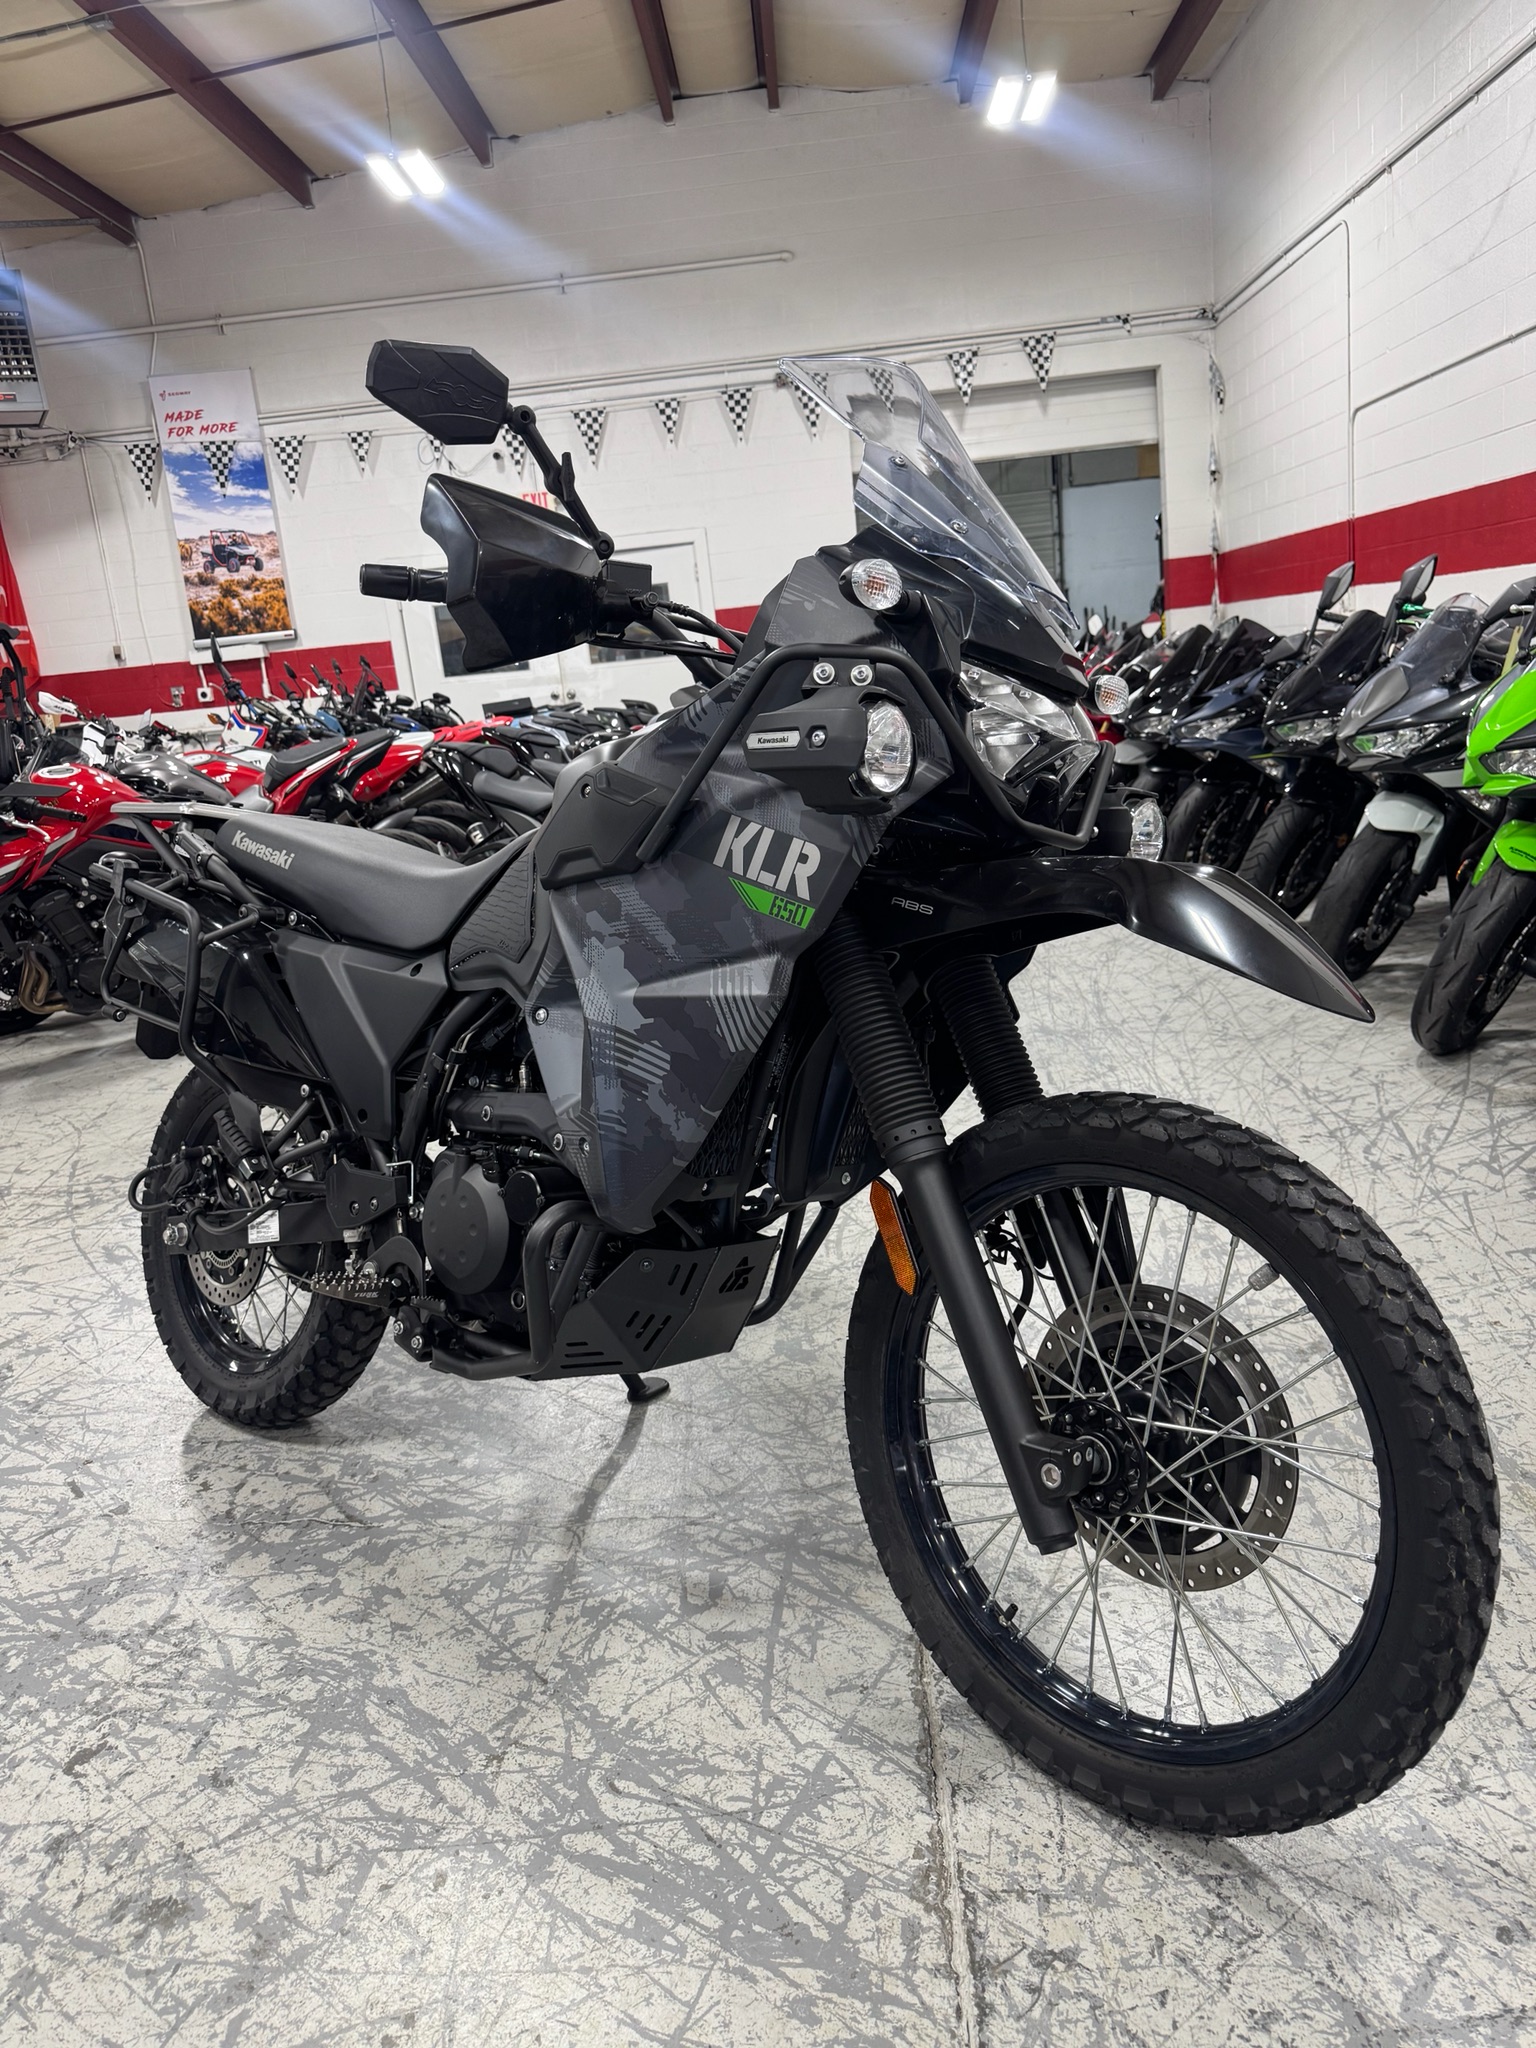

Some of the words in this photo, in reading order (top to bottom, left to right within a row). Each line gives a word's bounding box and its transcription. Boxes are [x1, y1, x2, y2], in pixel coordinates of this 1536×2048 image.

[164, 409, 204, 423] MADE
[167, 425, 194, 439] FOR
[199, 421, 239, 435] MORE
[757, 735, 789, 744] Kawasaki
[231, 829, 296, 870] Kawasaki
[712, 814, 821, 901] KLR
[768, 895, 808, 927] 650
[891, 896, 934, 915] ABS
